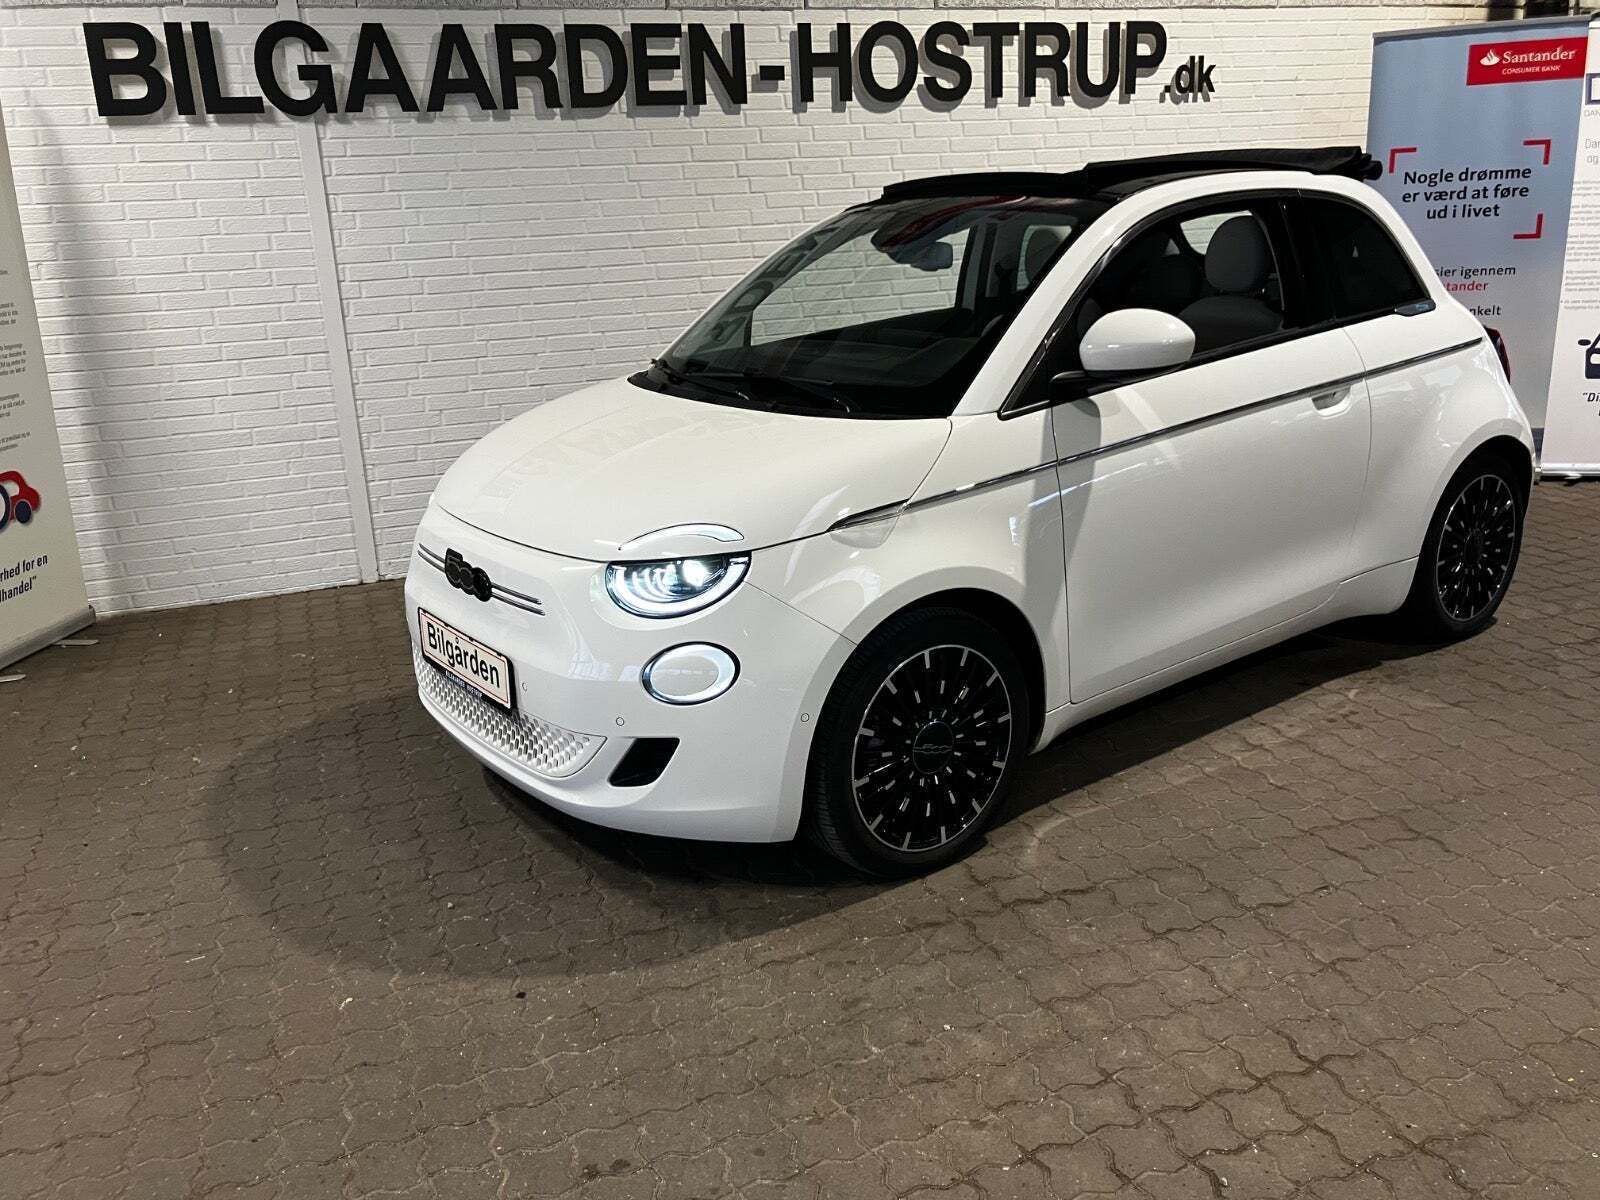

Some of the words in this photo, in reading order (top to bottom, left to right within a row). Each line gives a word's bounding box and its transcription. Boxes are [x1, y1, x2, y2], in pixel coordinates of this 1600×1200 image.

[1502, 45, 1576, 64] Santander
[83, 20, 1216, 117] BILGAARDEN-HOSTRUP.dk
[1502, 66, 1540, 75] CONSUMER
[1541, 65, 1561, 73] BANK
[1403, 168, 1454, 187] Nogle
[1458, 167, 1532, 182] drømme
[1402, 192, 1420, 203] er
[1424, 186, 1467, 201] værd
[1471, 186, 1489, 199] at
[1493, 184, 1530, 198] føre
[1426, 205, 1448, 219] ud
[1452, 205, 1458, 218] i
[1461, 204, 1501, 217] livet
[1460, 266, 1516, 279] igennem
[1444, 280, 1489, 292] tander
[22, 559, 35, 573] for
[36, 555, 48, 567] en
[427, 621, 501, 688] Bilgården
